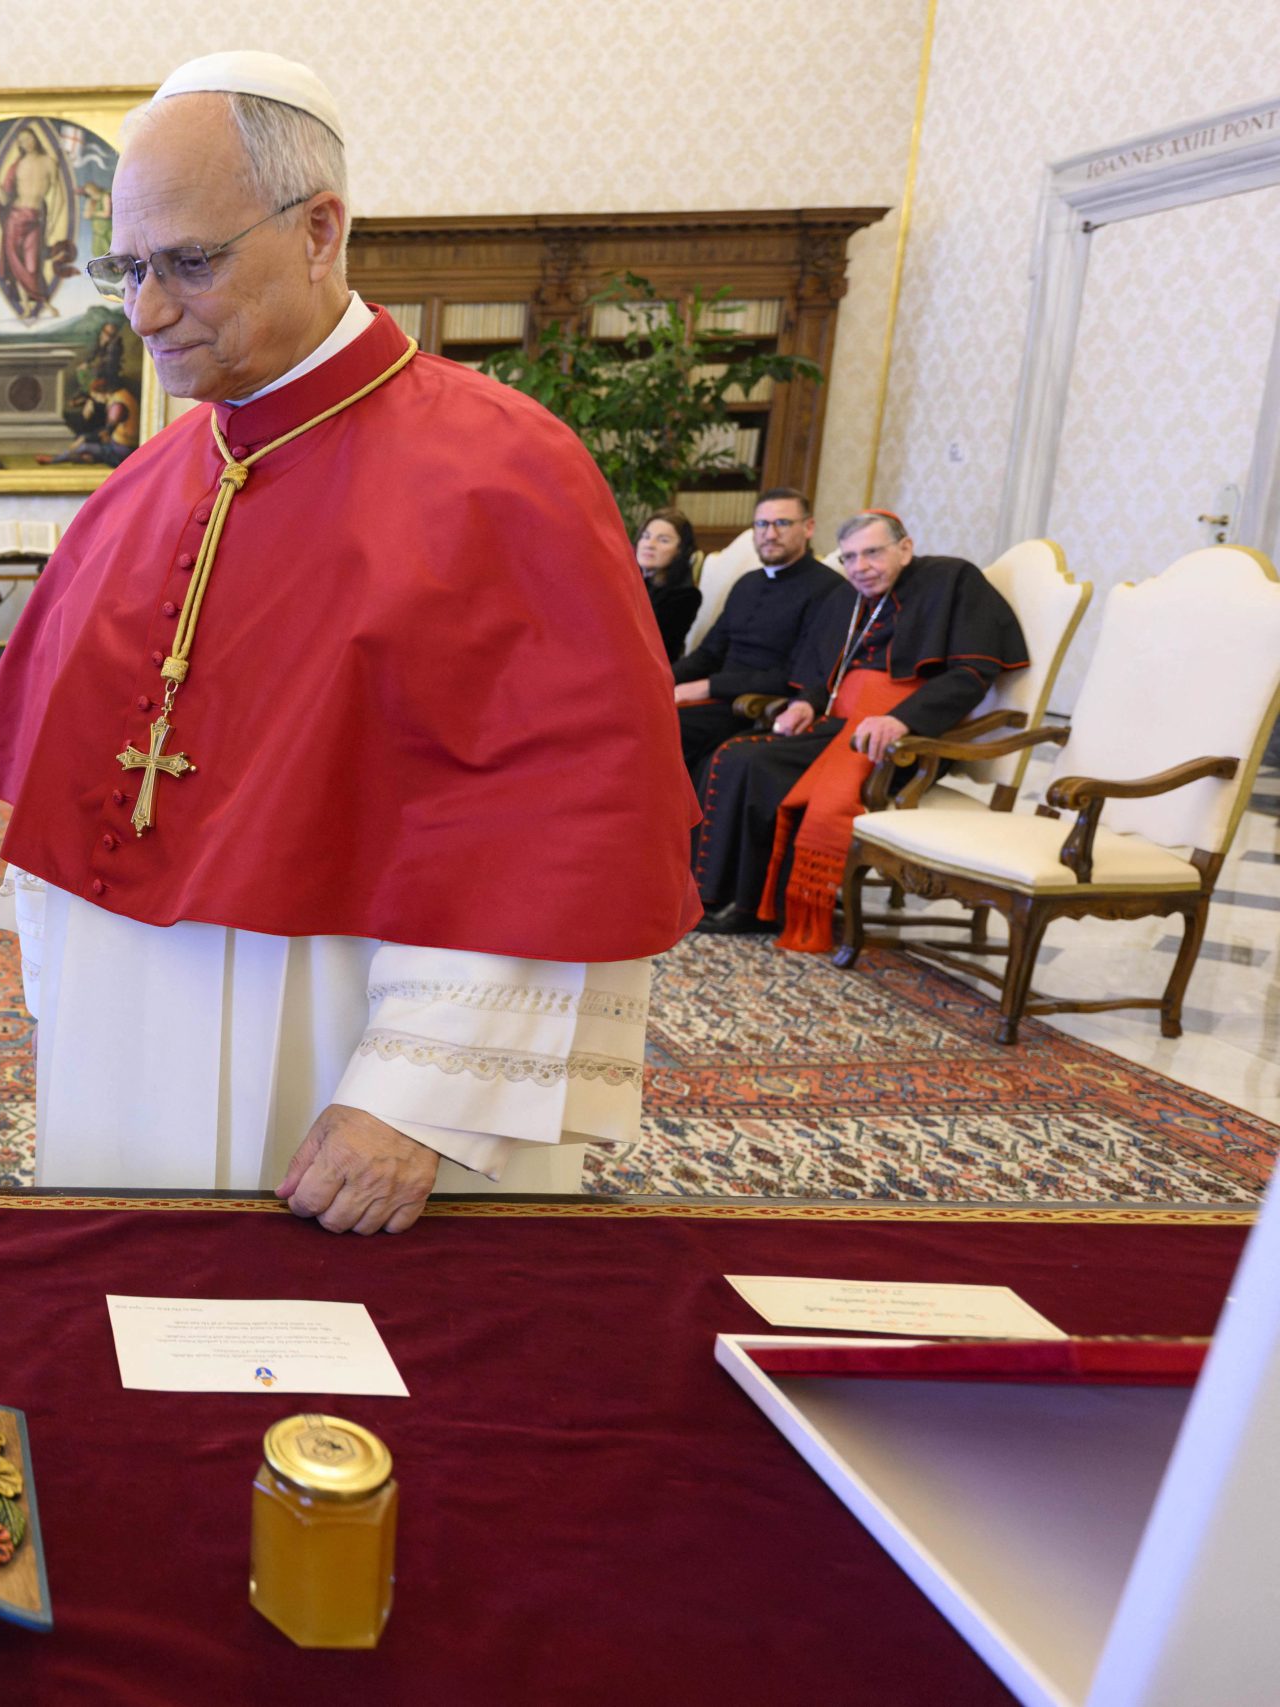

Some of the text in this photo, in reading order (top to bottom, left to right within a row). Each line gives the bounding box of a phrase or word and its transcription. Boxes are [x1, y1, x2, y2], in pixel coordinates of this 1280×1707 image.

[1086, 109, 1278, 180] IOANNES XXIII PONT
